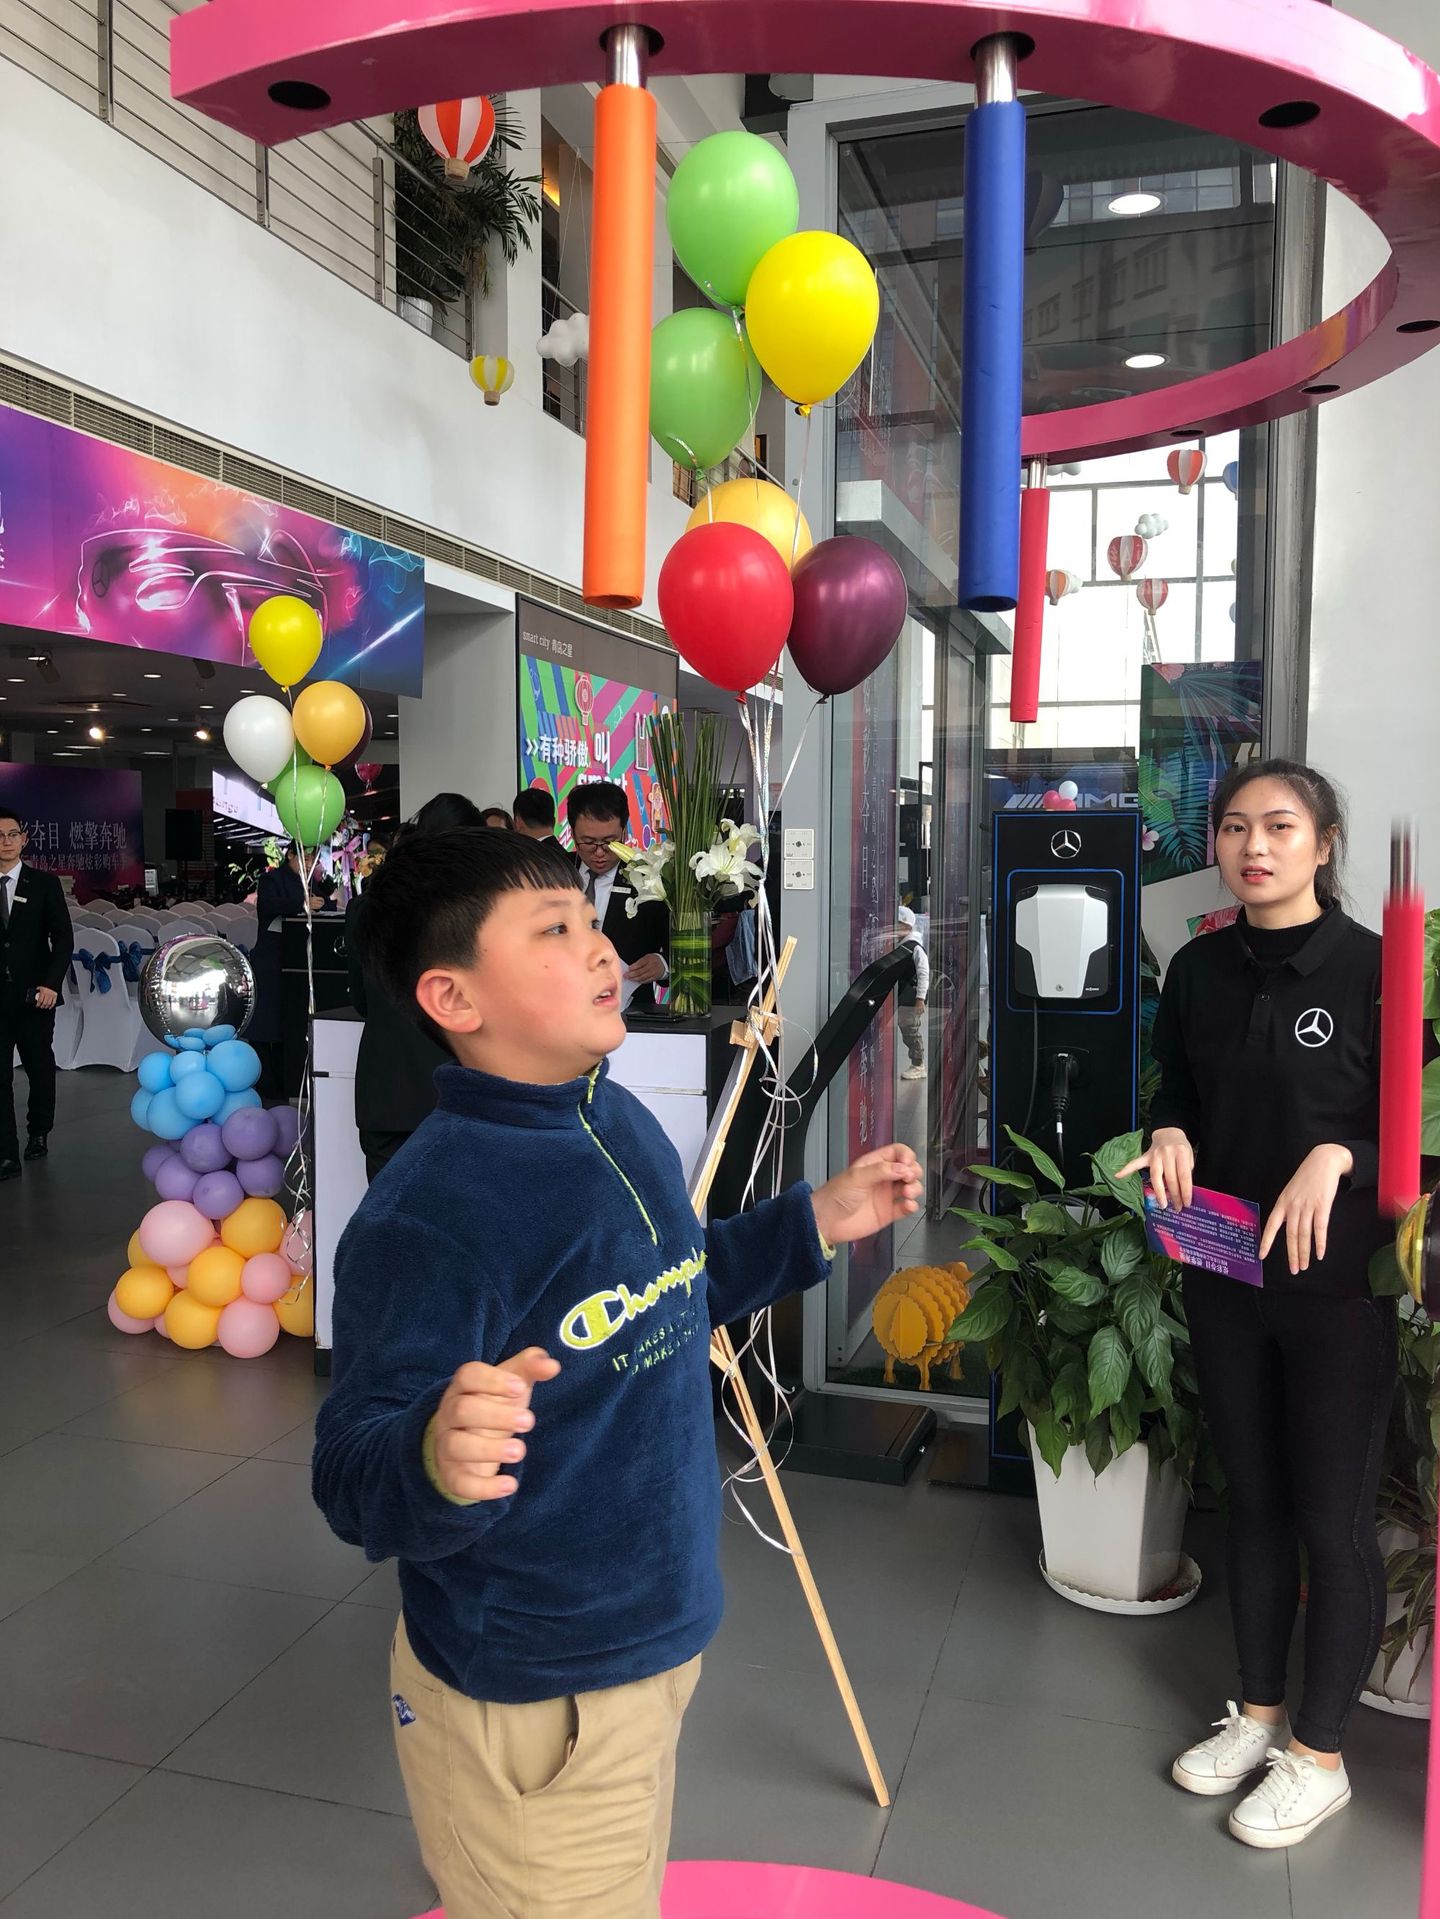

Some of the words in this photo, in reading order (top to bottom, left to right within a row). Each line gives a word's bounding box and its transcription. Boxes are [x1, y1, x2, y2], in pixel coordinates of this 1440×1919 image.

[523, 631, 538, 645] smart
[540, 635, 550, 651] city
[540, 734, 590, 768] 有种骄傲
[595, 731, 610, 775] 叫
[69, 820, 127, 851] 燃擎奔驰
[612, 1353, 629, 1372] IT
